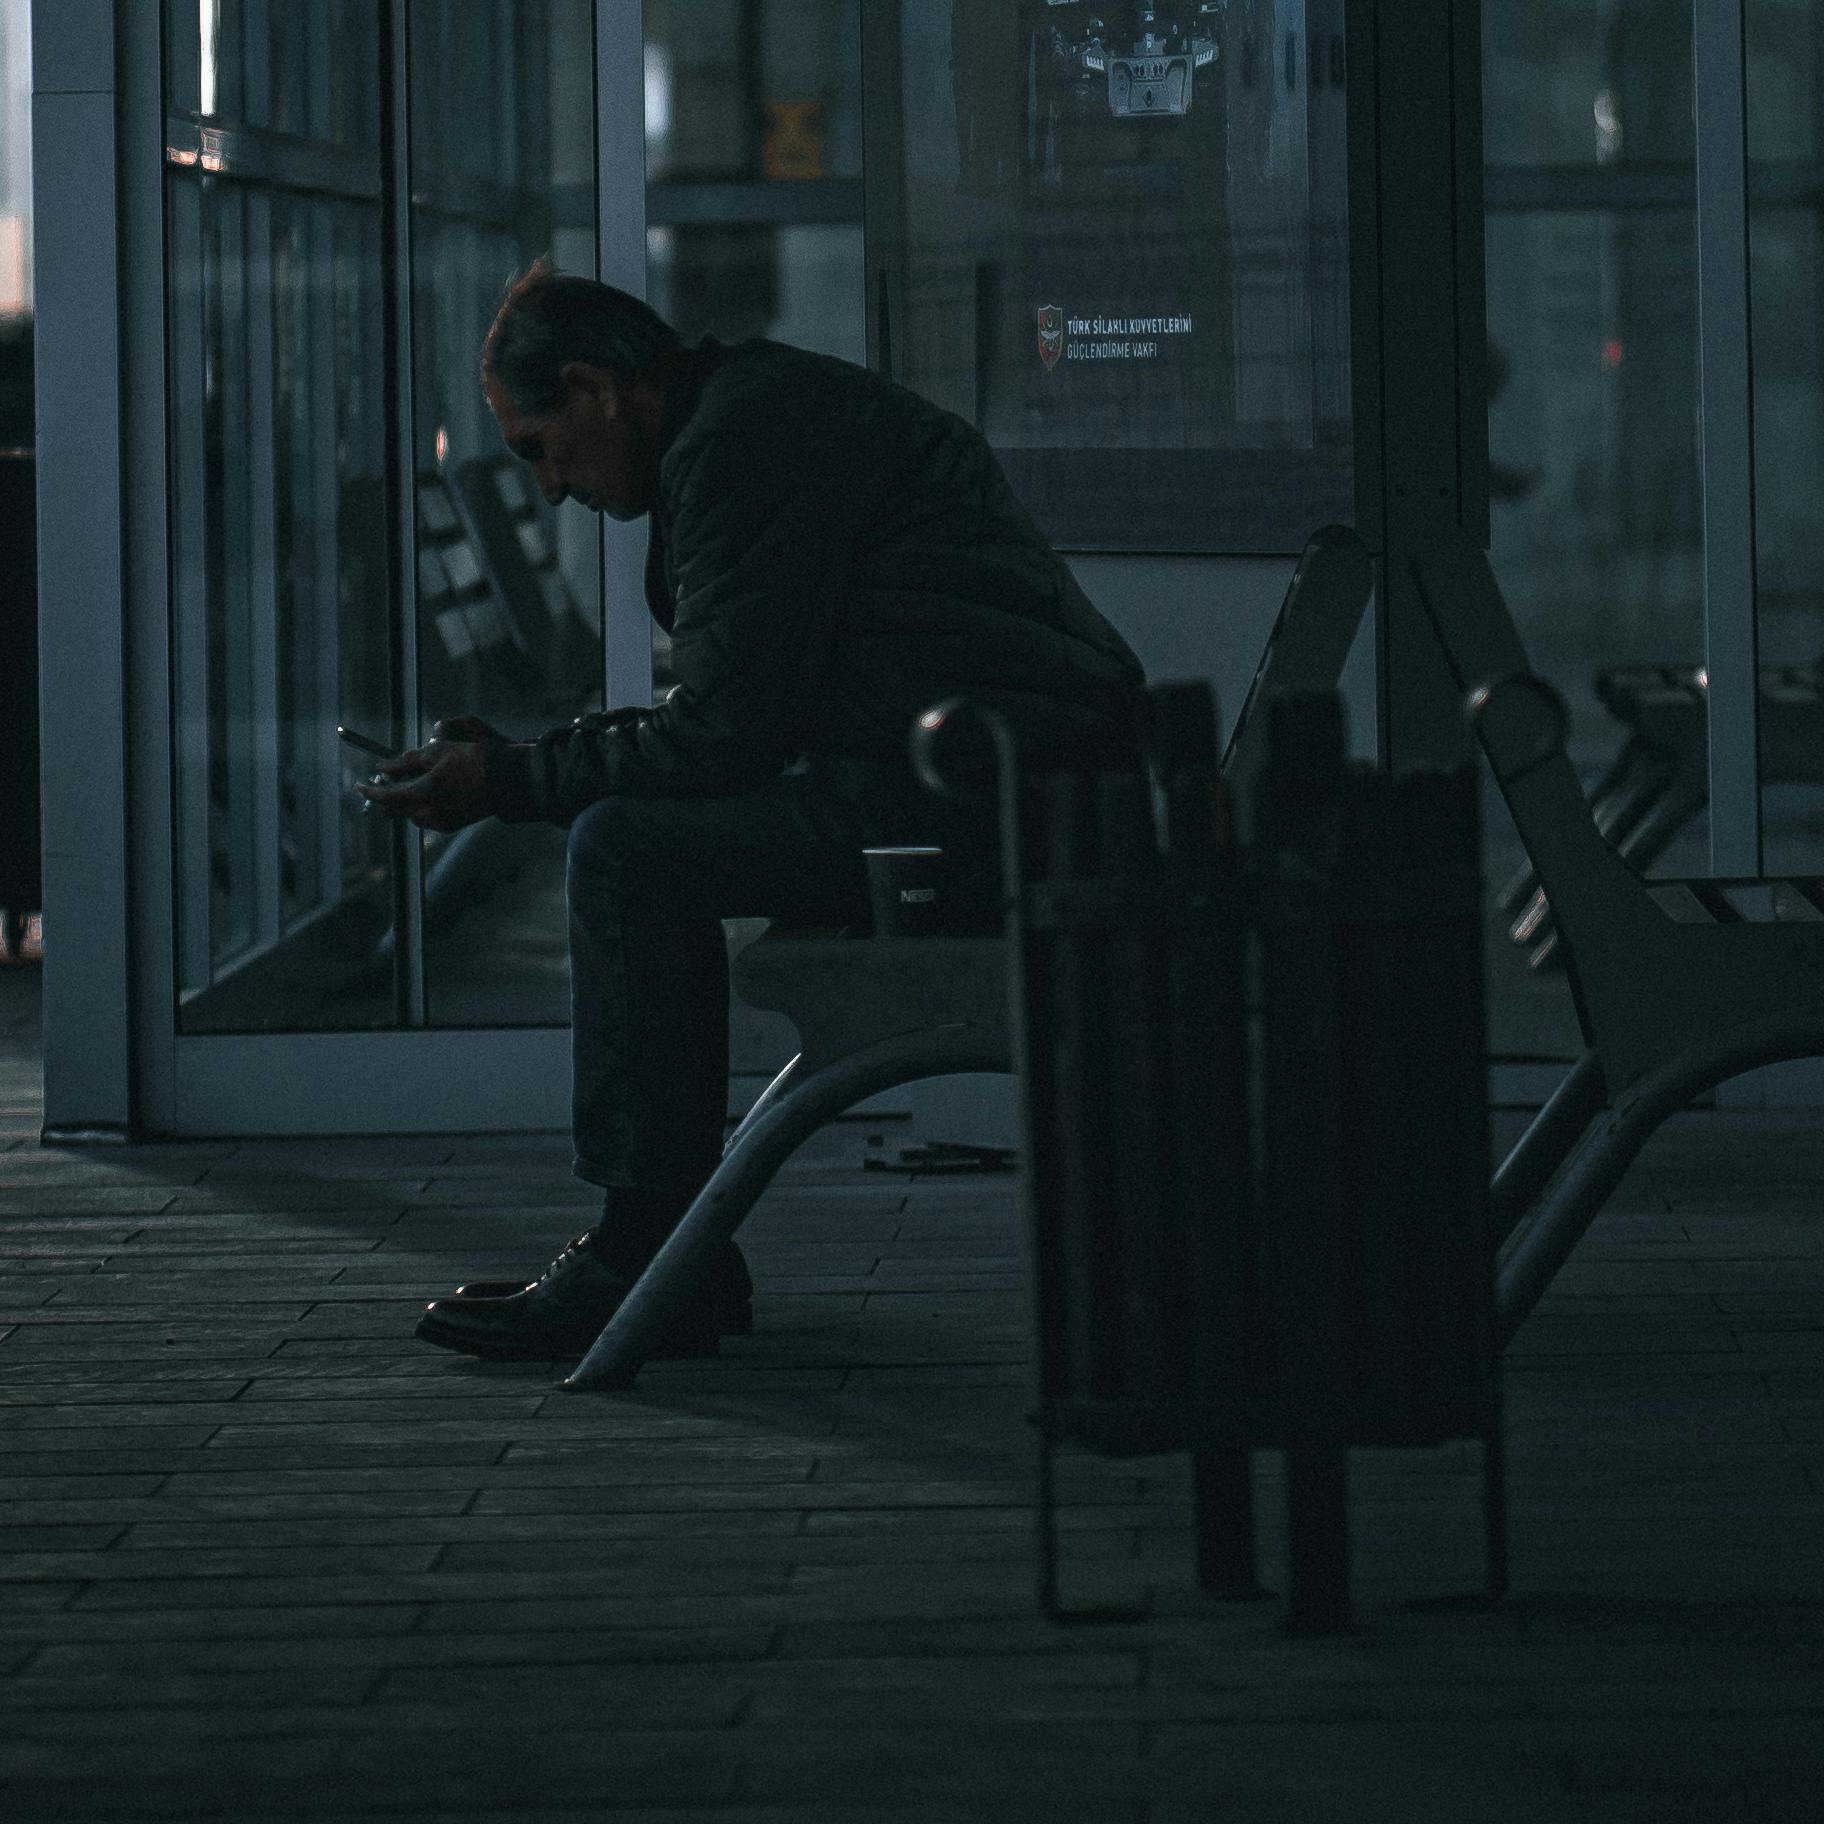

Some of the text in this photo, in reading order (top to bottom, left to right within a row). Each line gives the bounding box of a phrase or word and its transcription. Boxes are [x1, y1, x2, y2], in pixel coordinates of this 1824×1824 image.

[1067, 315, 1091, 336] TÜRK
[1067, 339, 1158, 361] GÜÇLENDİRME VAKFI
